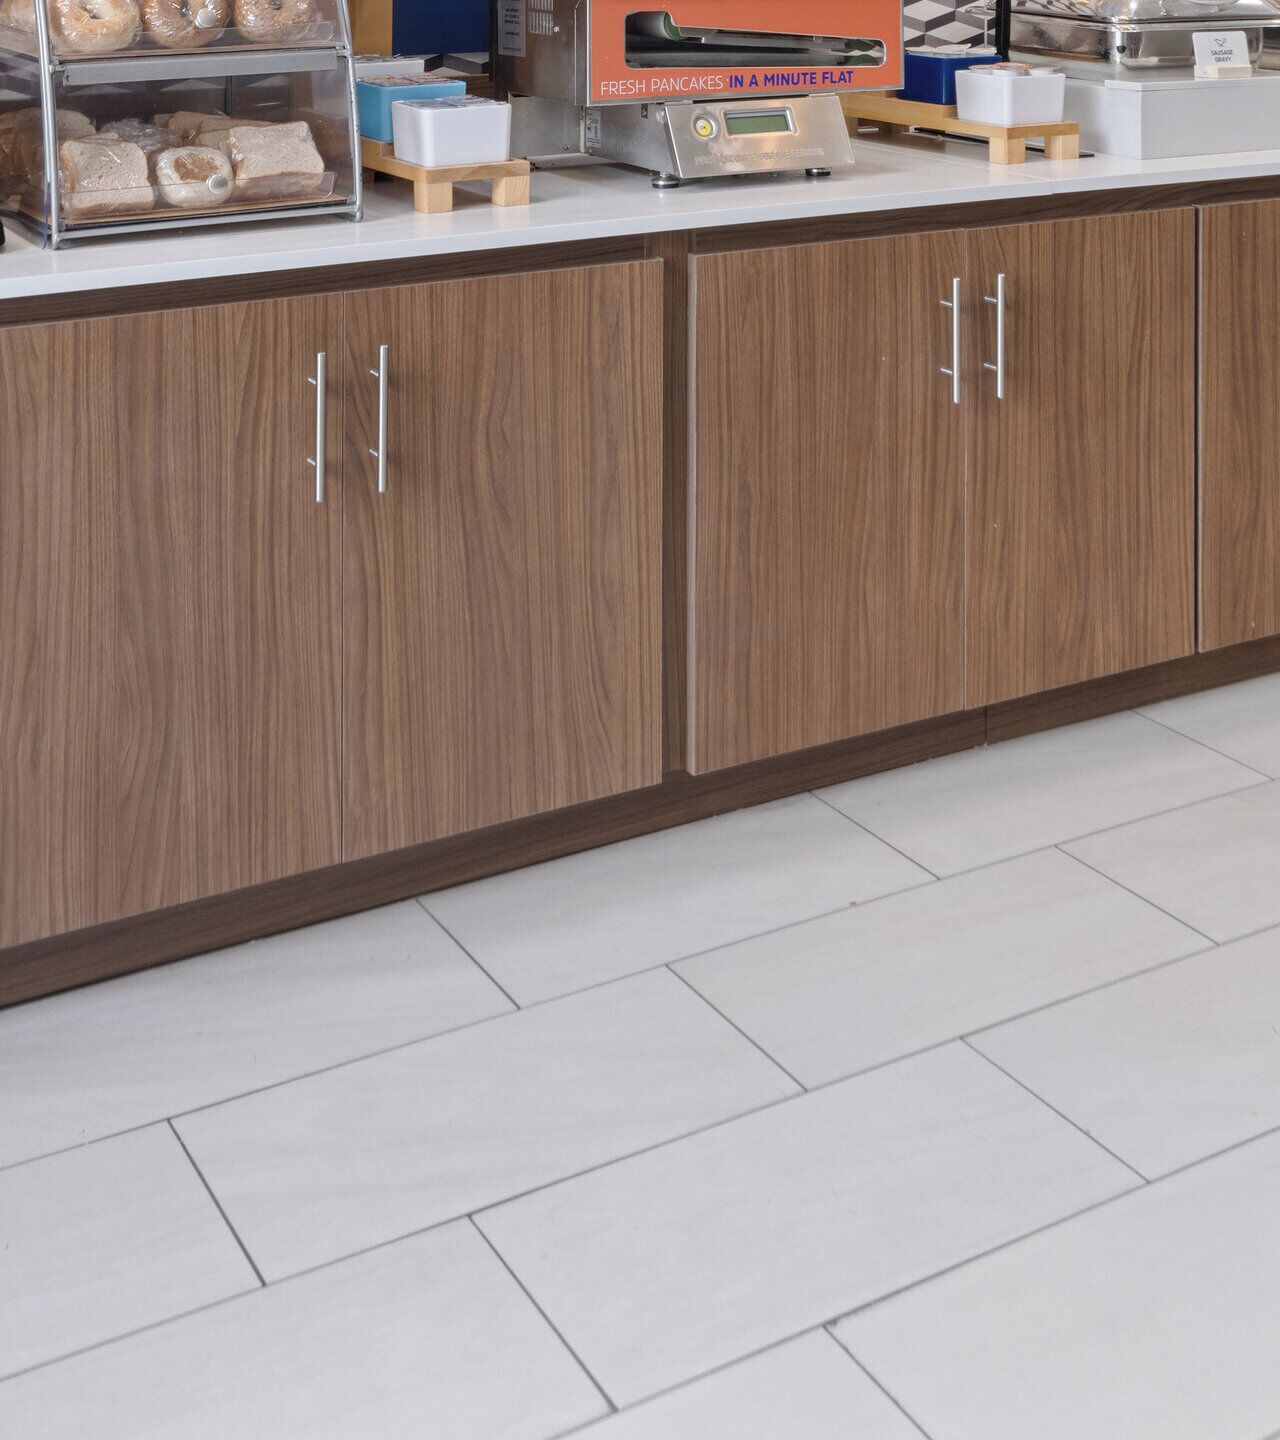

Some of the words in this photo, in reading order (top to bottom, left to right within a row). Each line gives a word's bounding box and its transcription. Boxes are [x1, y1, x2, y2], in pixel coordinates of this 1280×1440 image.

[600, 79, 646, 96] FRESH
[650, 74, 724, 93] PANCAKES
[728, 73, 744, 89] IN
[748, 73, 760, 88] A
[763, 71, 818, 87] MINUTE
[821, 69, 854, 85] FLAT
